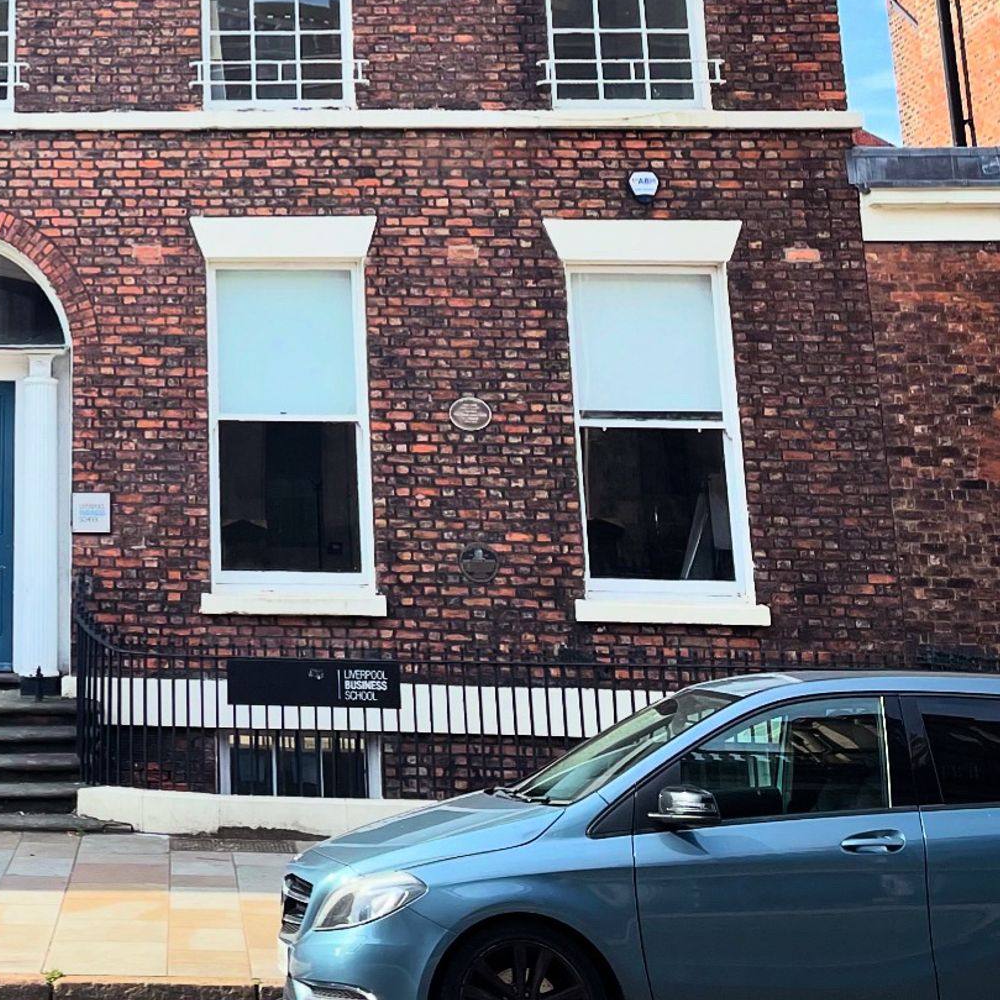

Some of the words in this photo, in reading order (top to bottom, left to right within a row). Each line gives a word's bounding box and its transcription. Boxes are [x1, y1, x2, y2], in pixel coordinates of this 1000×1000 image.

[343, 669, 388, 680] LIVERPOOL
[344, 680, 388, 691] BUSINESS
[344, 690, 378, 700] SCHOOL
